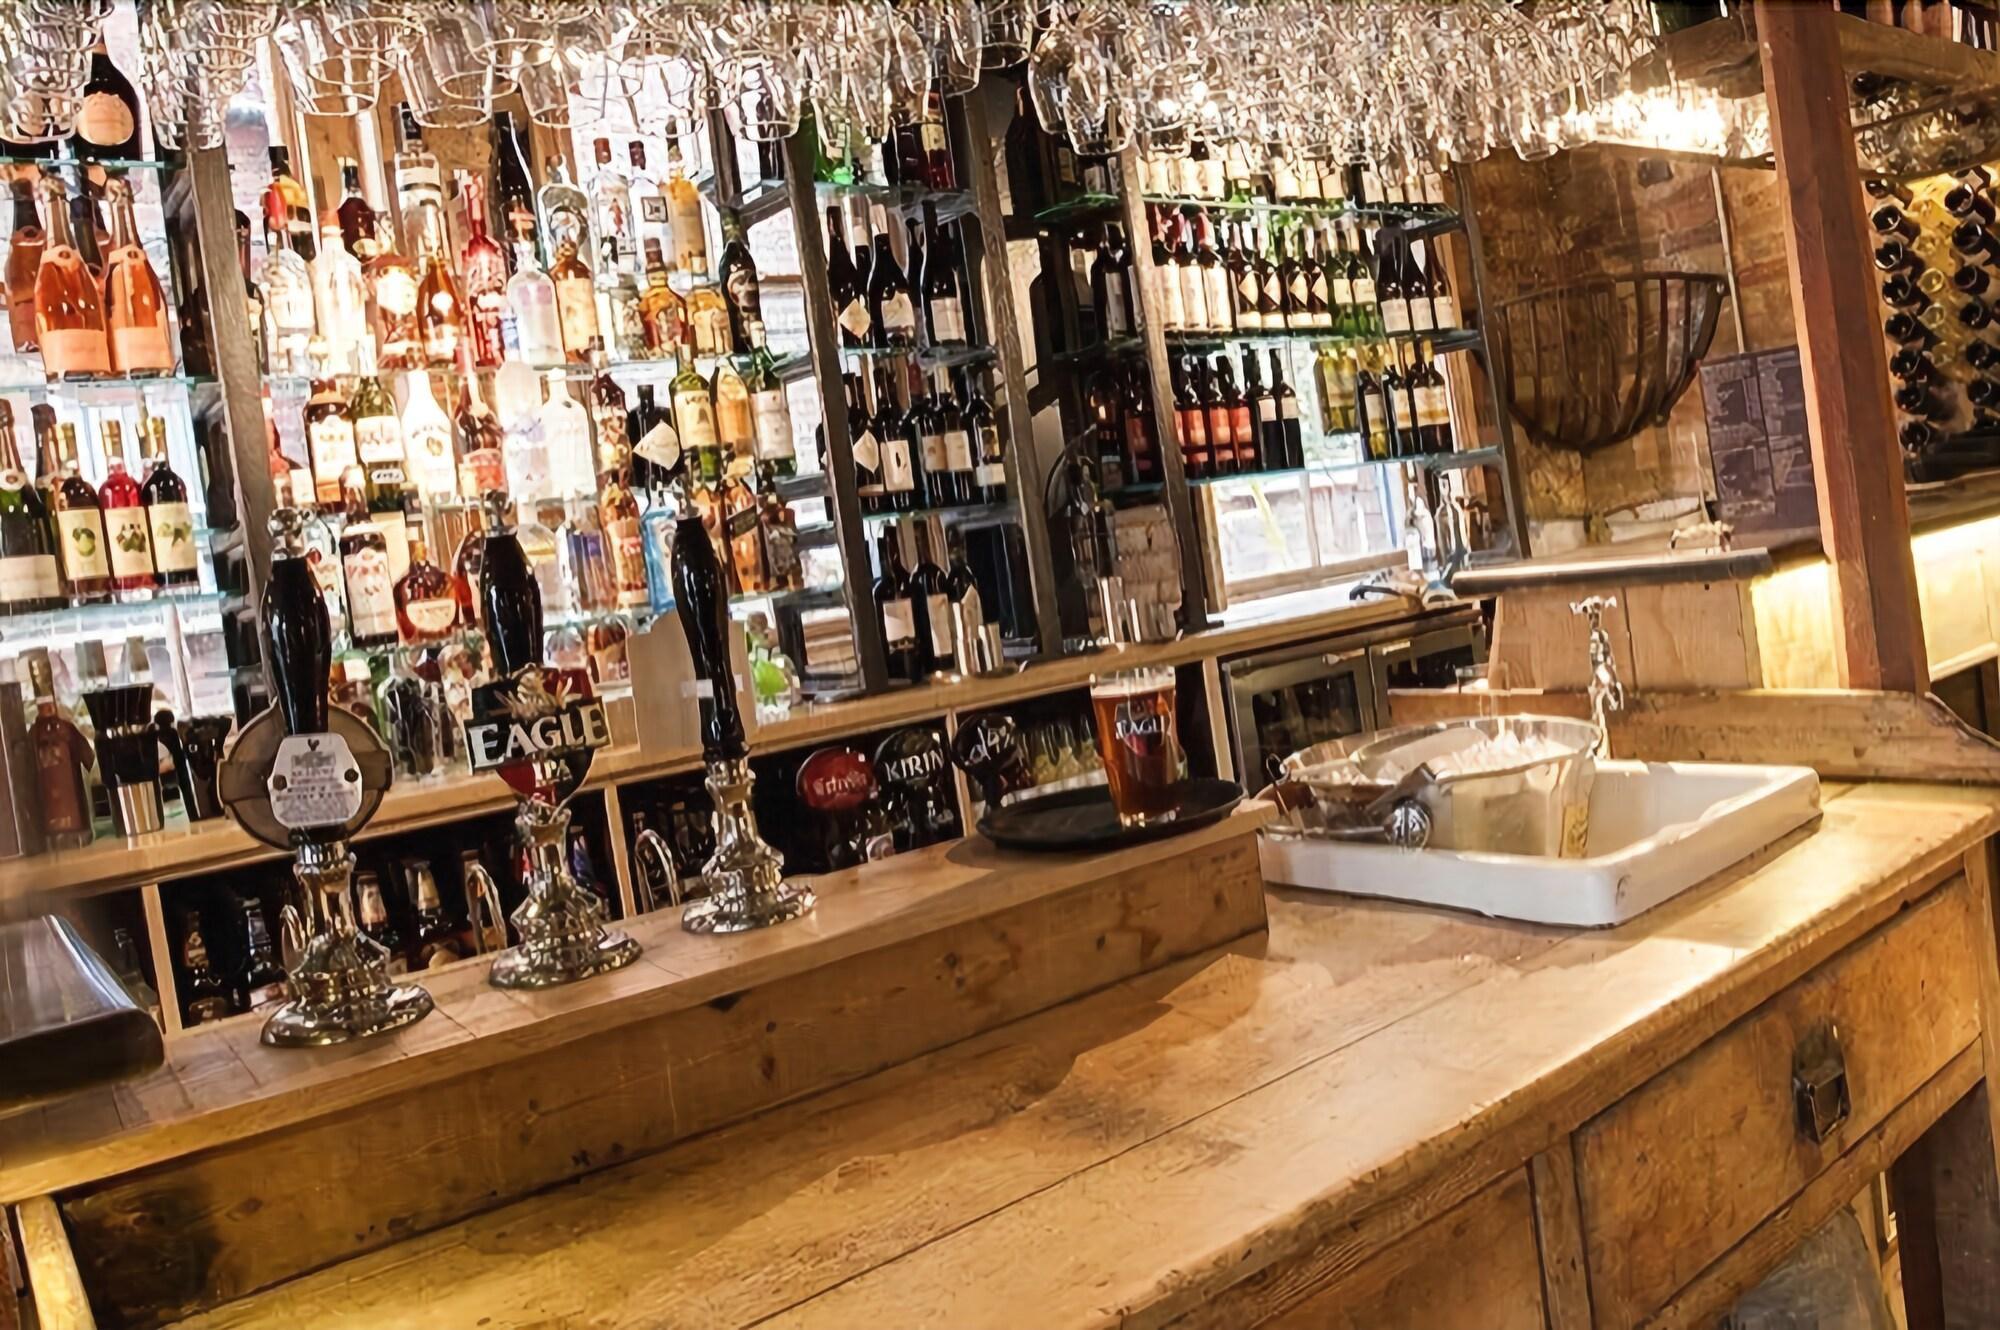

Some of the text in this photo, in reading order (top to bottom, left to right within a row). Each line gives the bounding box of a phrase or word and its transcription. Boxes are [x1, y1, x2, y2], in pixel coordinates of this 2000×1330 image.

[468, 702, 608, 769] EAGLE
[532, 757, 573, 786] IPA
[884, 748, 944, 782] KIRIN
